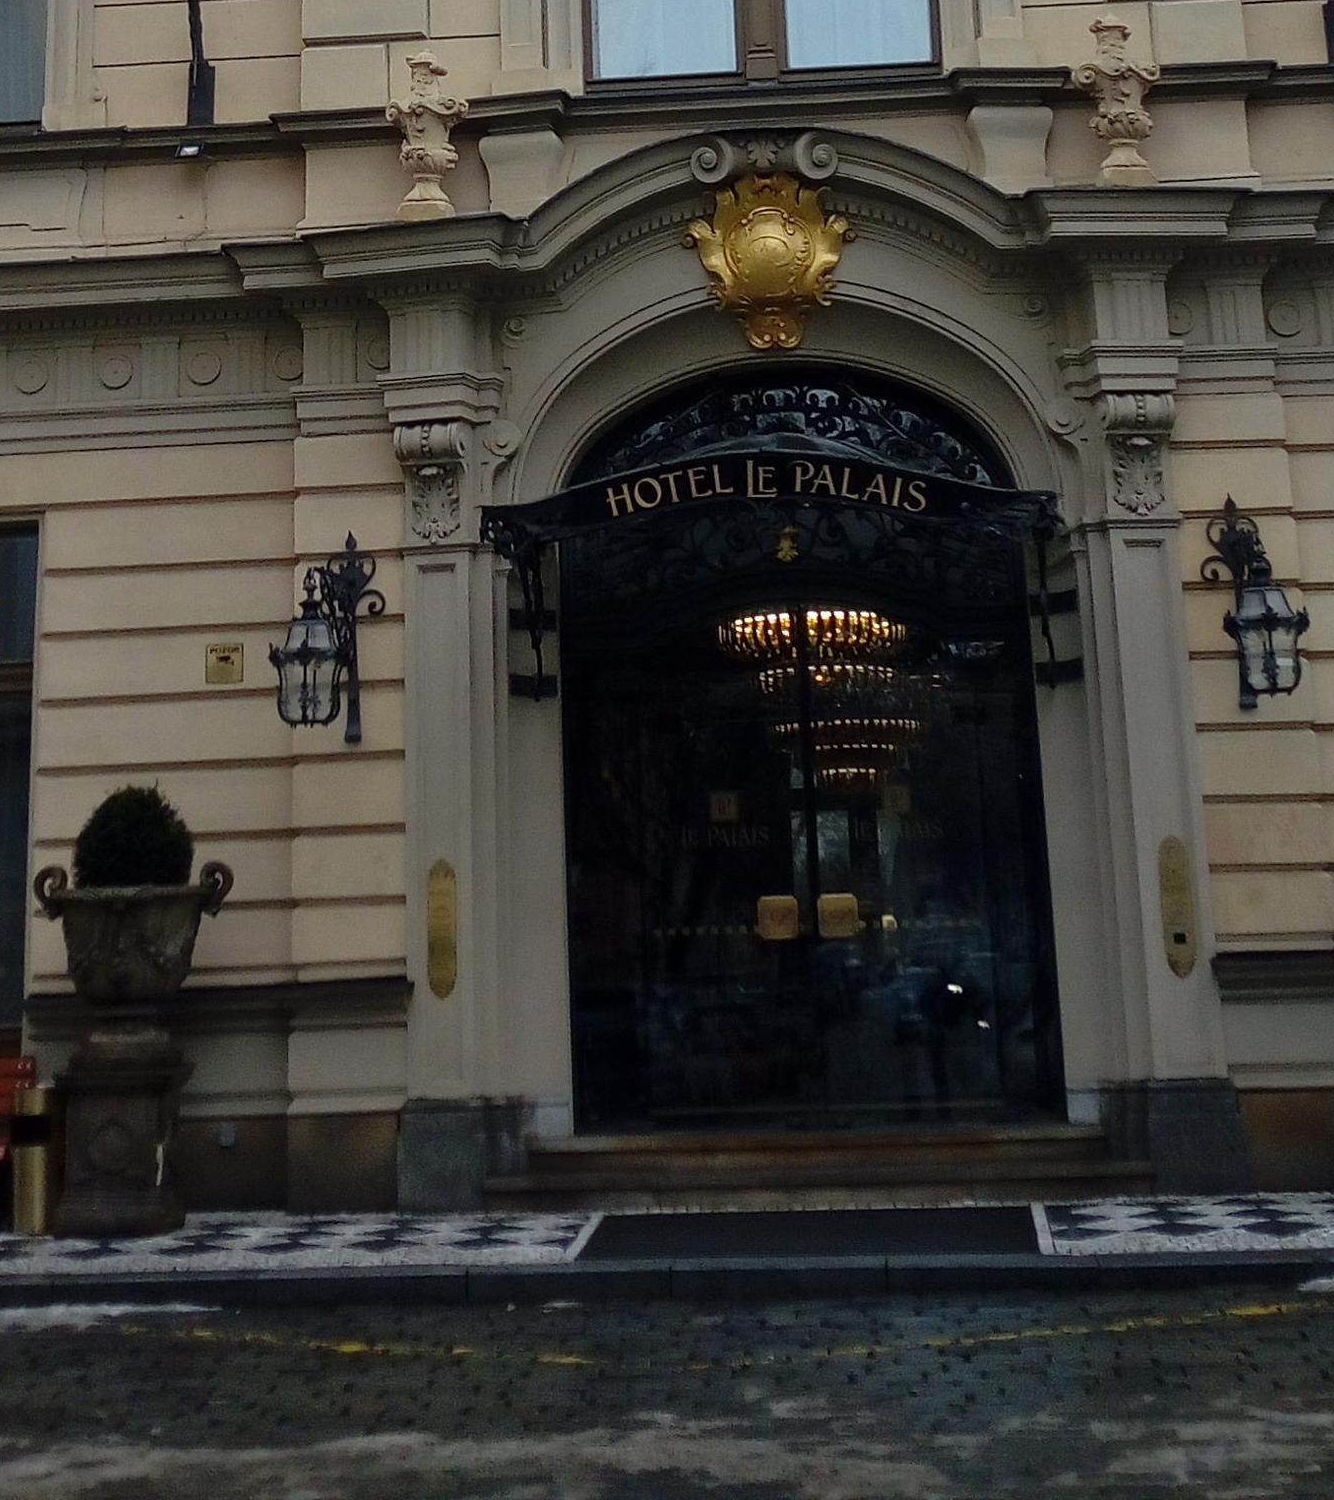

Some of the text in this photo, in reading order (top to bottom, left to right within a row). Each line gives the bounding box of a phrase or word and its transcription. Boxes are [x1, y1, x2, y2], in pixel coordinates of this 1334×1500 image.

[605, 459, 928, 518] HOTEL LE PALAIS
